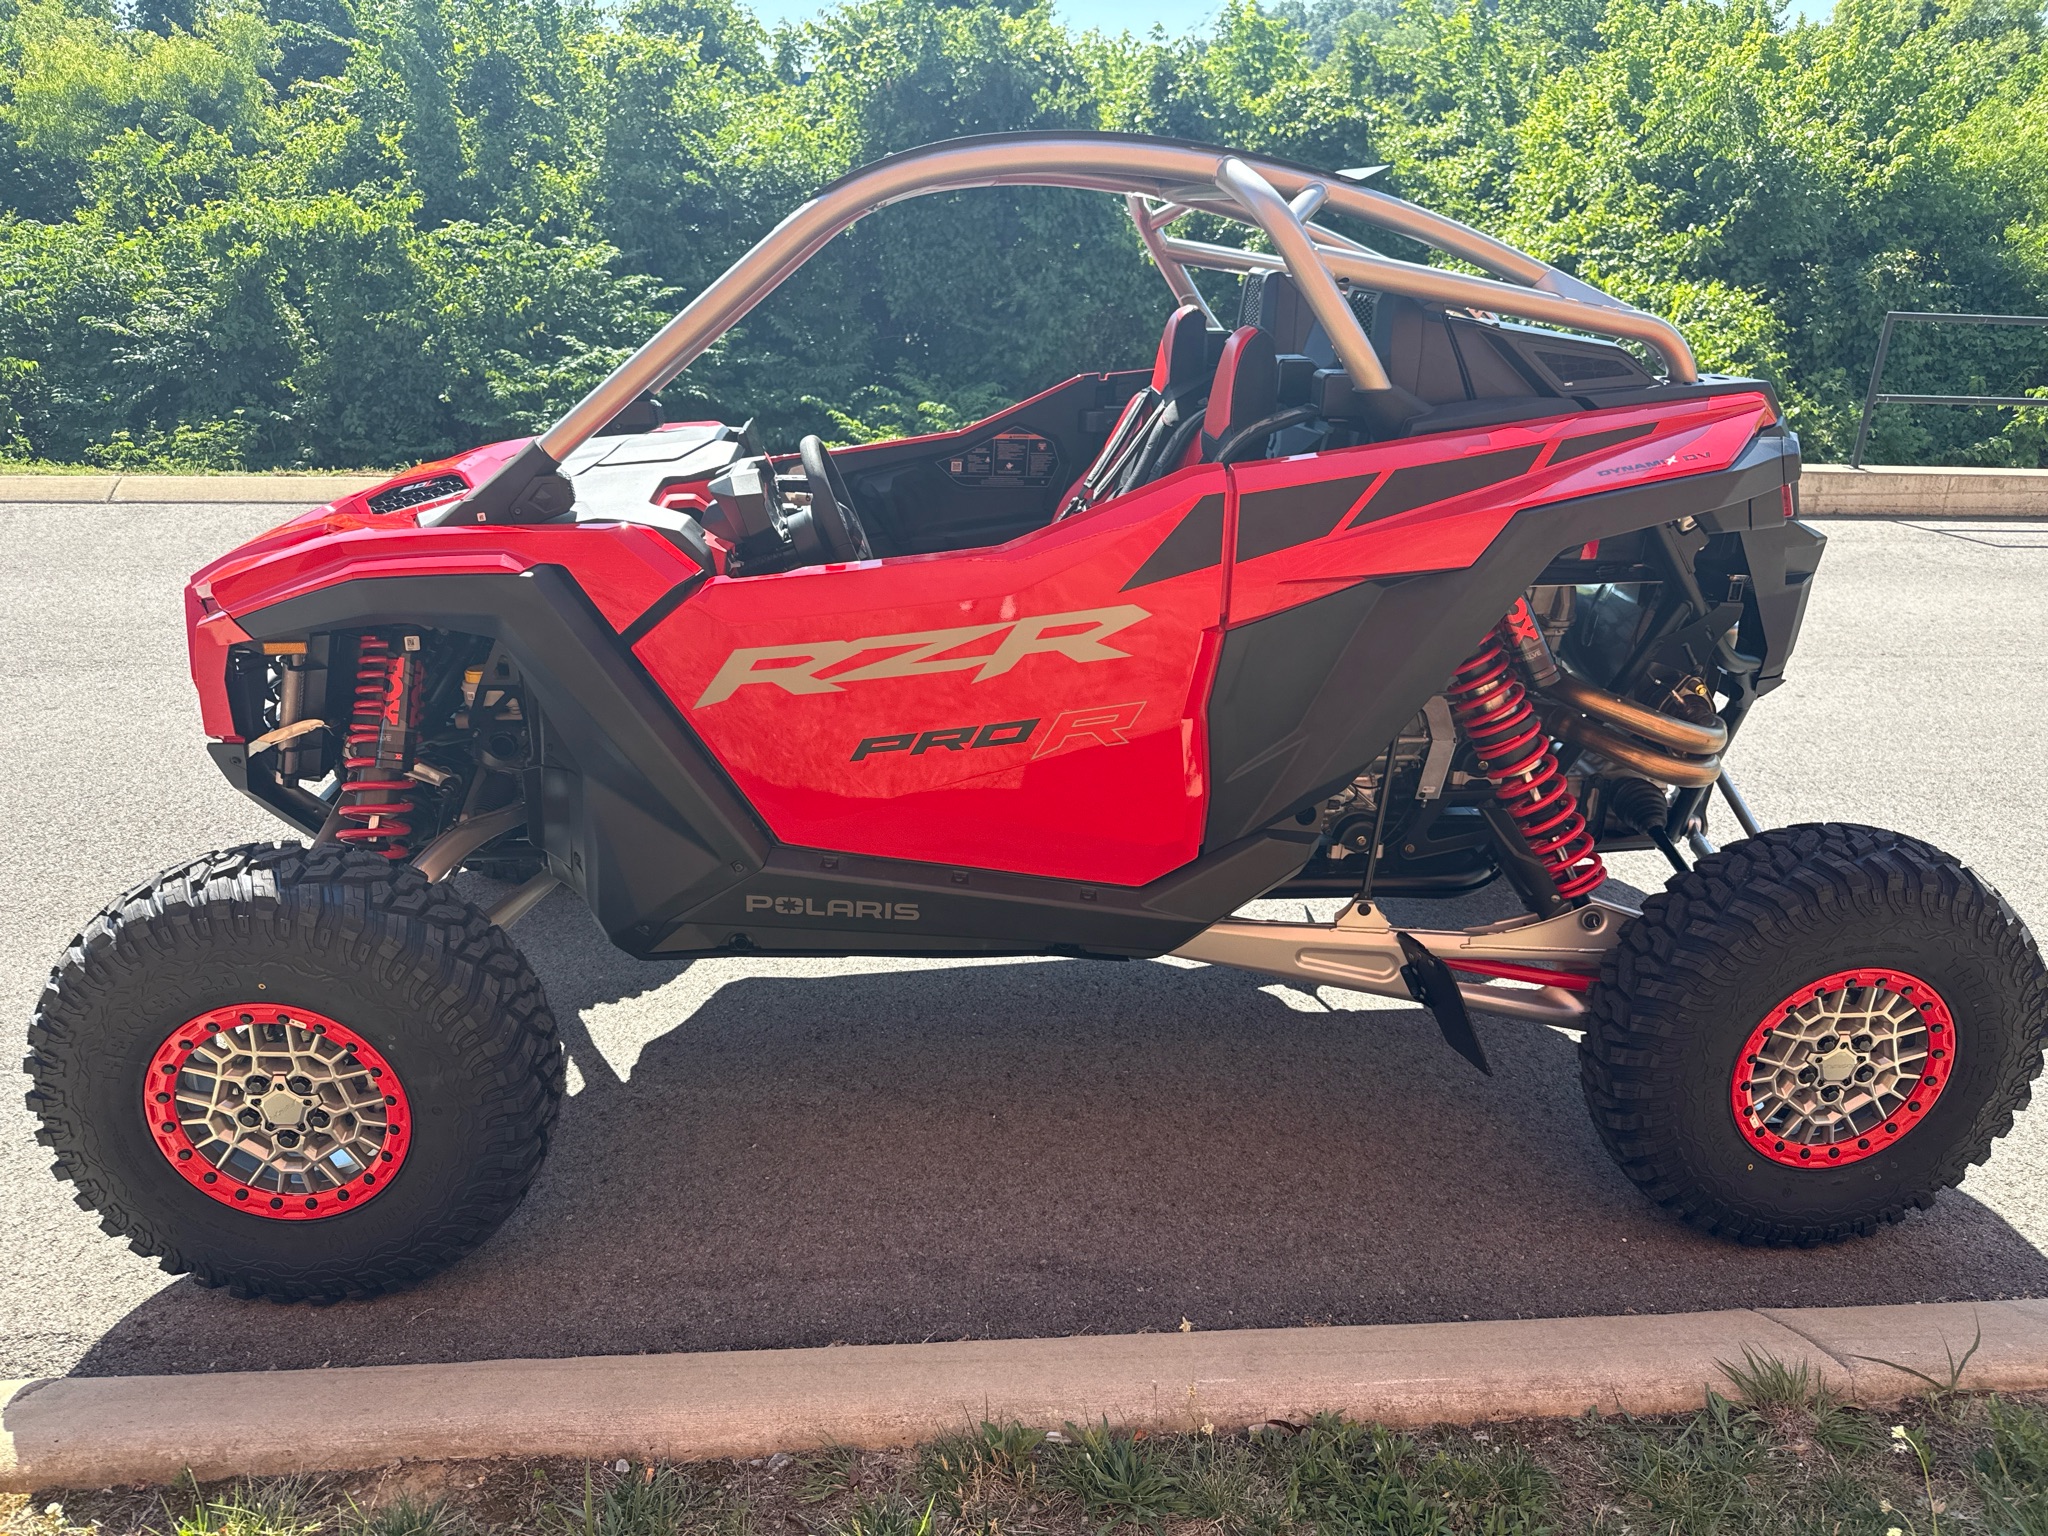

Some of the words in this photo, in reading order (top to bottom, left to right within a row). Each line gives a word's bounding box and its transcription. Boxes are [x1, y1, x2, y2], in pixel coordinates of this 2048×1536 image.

[1597, 455, 1678, 477] DYNAMIX
[1683, 452, 1711, 462] DV
[1507, 597, 1540, 648] OX
[692, 604, 1153, 710] RZR
[382, 657, 406, 726] FOX
[849, 718, 1042, 762] PRO
[1031, 701, 1148, 760] R
[745, 894, 920, 921] POLARIS
